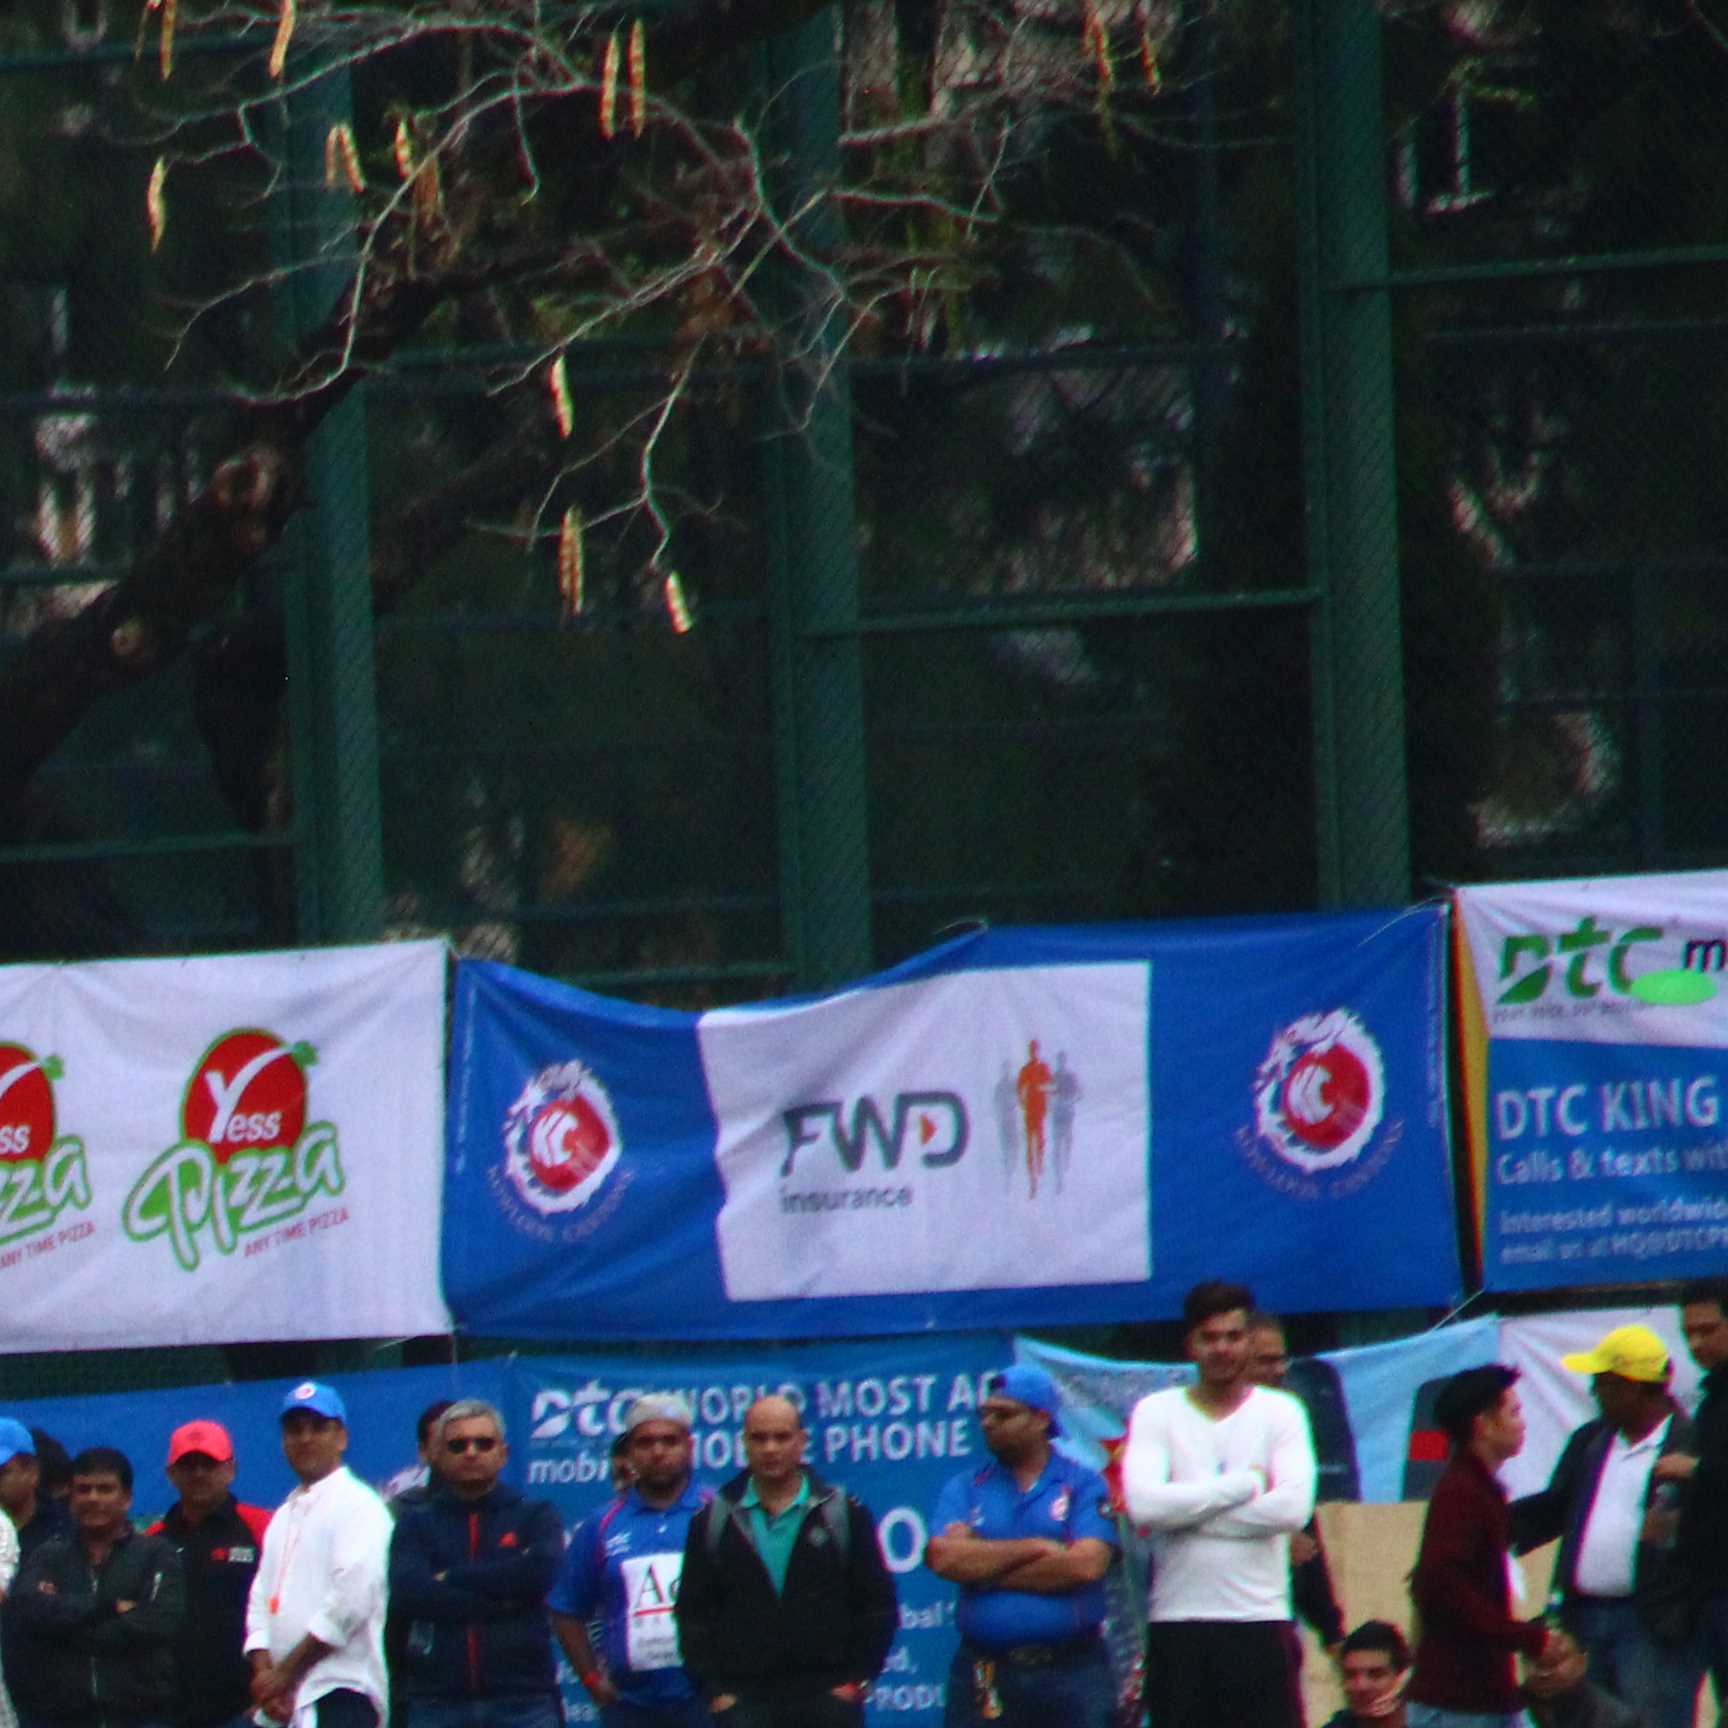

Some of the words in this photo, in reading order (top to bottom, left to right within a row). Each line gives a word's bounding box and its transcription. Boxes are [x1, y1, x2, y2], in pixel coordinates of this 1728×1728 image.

[205, 1048, 291, 1143] Yess
[1497, 1083, 1588, 1141] DTC
[1602, 1075, 1719, 1133] KING
[781, 1090, 970, 1178] FWD
[1497, 1150, 1564, 1185] Calls
[1600, 1145, 1681, 1178] texts
[122, 1120, 345, 1272] Pizza
[779, 1185, 914, 1214] insurance
[817, 1375, 937, 1418] MOST
[825, 1418, 972, 1463] PHONE
[528, 1450, 611, 1484] mobi
